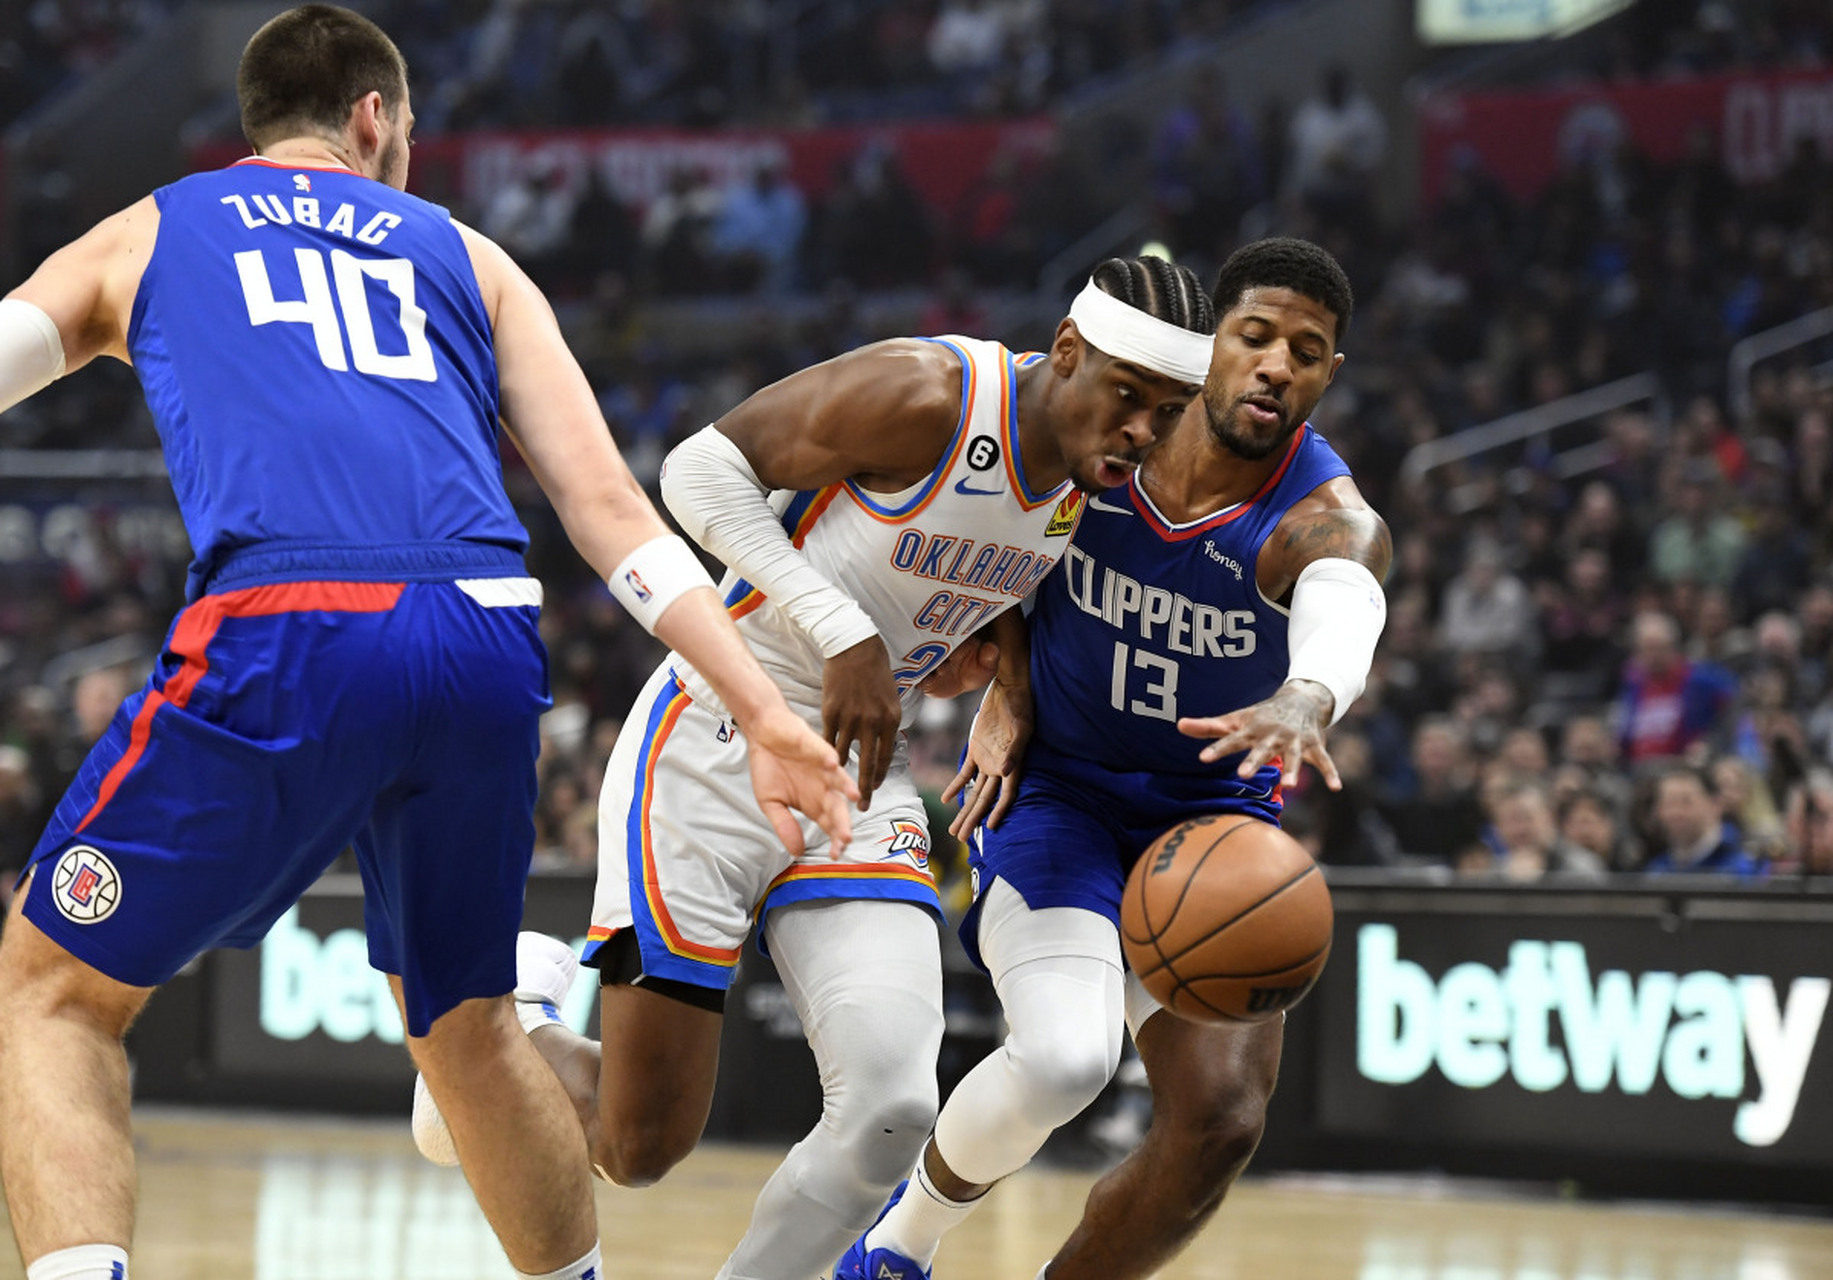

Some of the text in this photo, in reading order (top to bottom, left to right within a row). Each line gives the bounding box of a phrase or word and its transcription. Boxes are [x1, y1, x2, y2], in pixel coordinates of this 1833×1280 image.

[220, 194, 402, 245] ZUBAC
[233, 248, 438, 382] 40
[971, 439, 994, 468] 6
[890, 528, 1055, 598] OKLAHOM
[1204, 540, 1243, 581] honey
[913, 590, 1004, 636] CITY
[1064, 543, 1257, 658] CLIPPERS
[1111, 641, 1180, 723] 13
[1357, 923, 1832, 1148] betway
